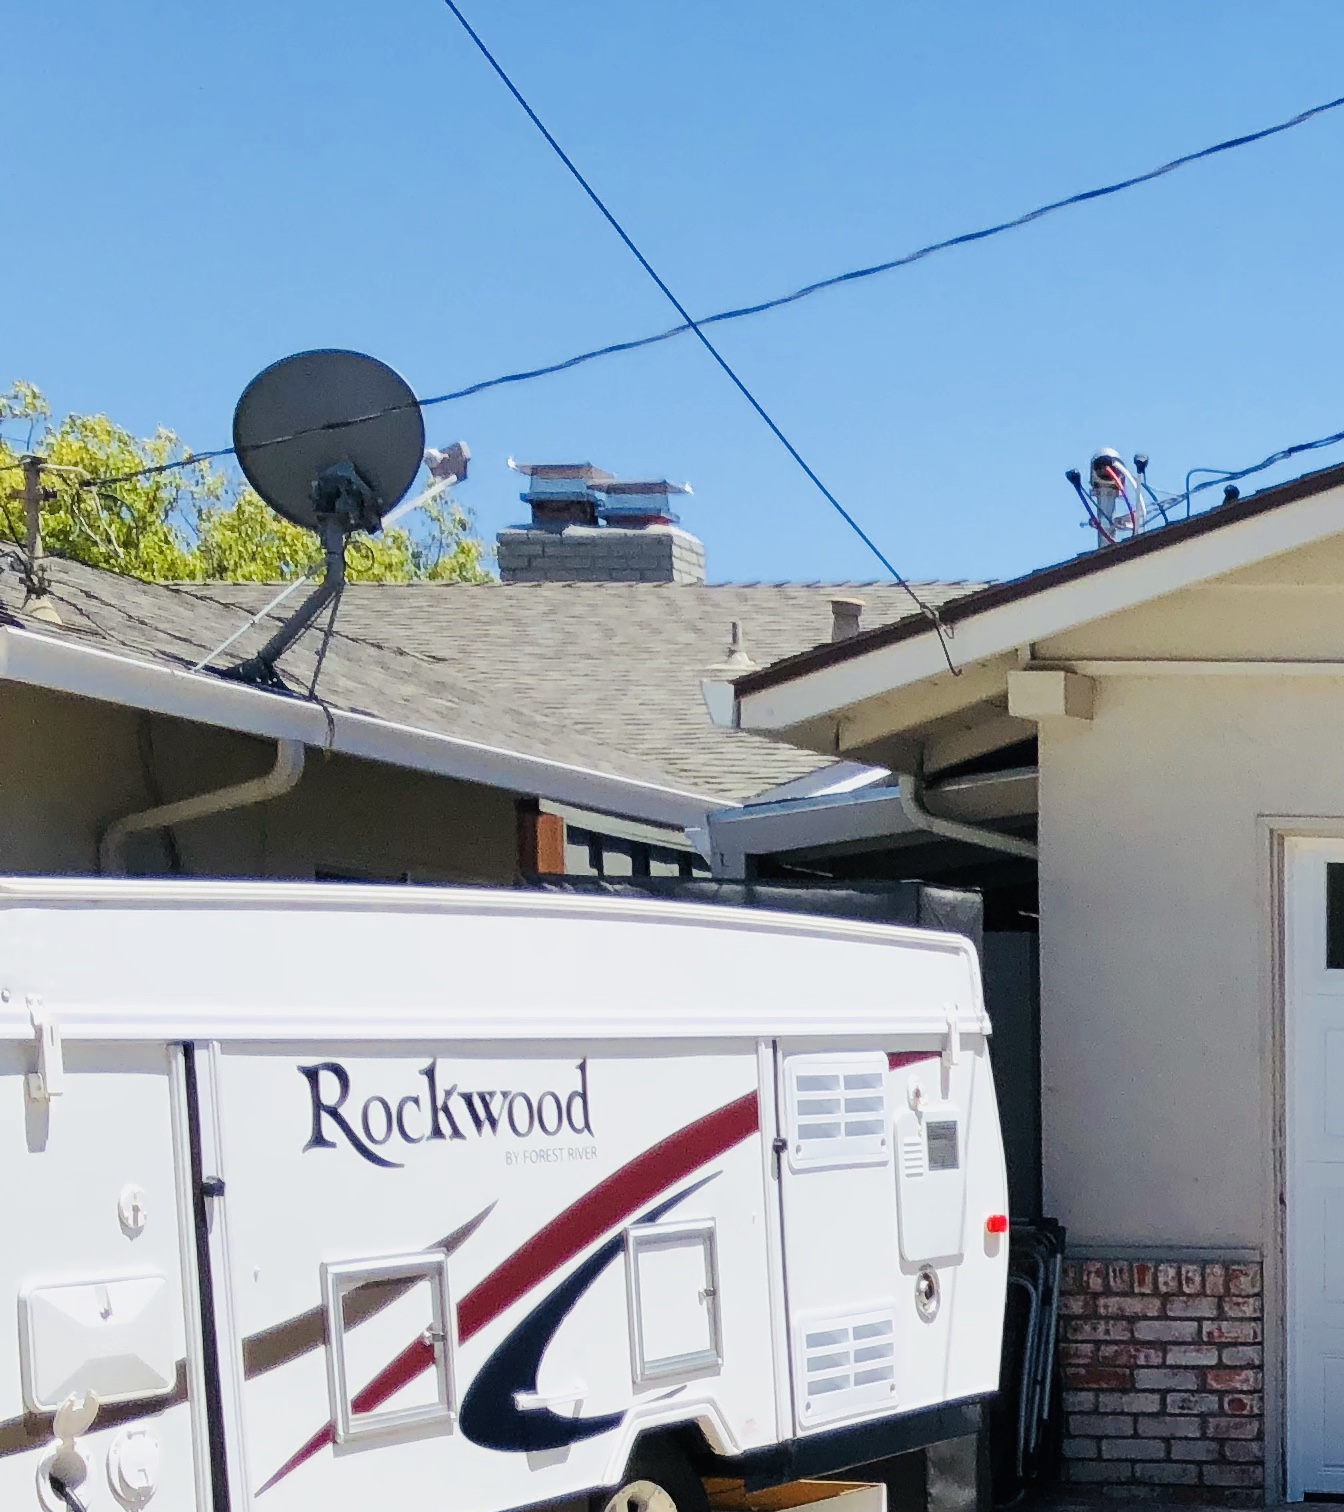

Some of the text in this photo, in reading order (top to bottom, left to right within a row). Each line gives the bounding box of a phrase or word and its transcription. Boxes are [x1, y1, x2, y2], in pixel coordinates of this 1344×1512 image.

[297, 1056, 596, 1168] Rockwood
[505, 1145, 598, 1166] BY FOREST RIVER
